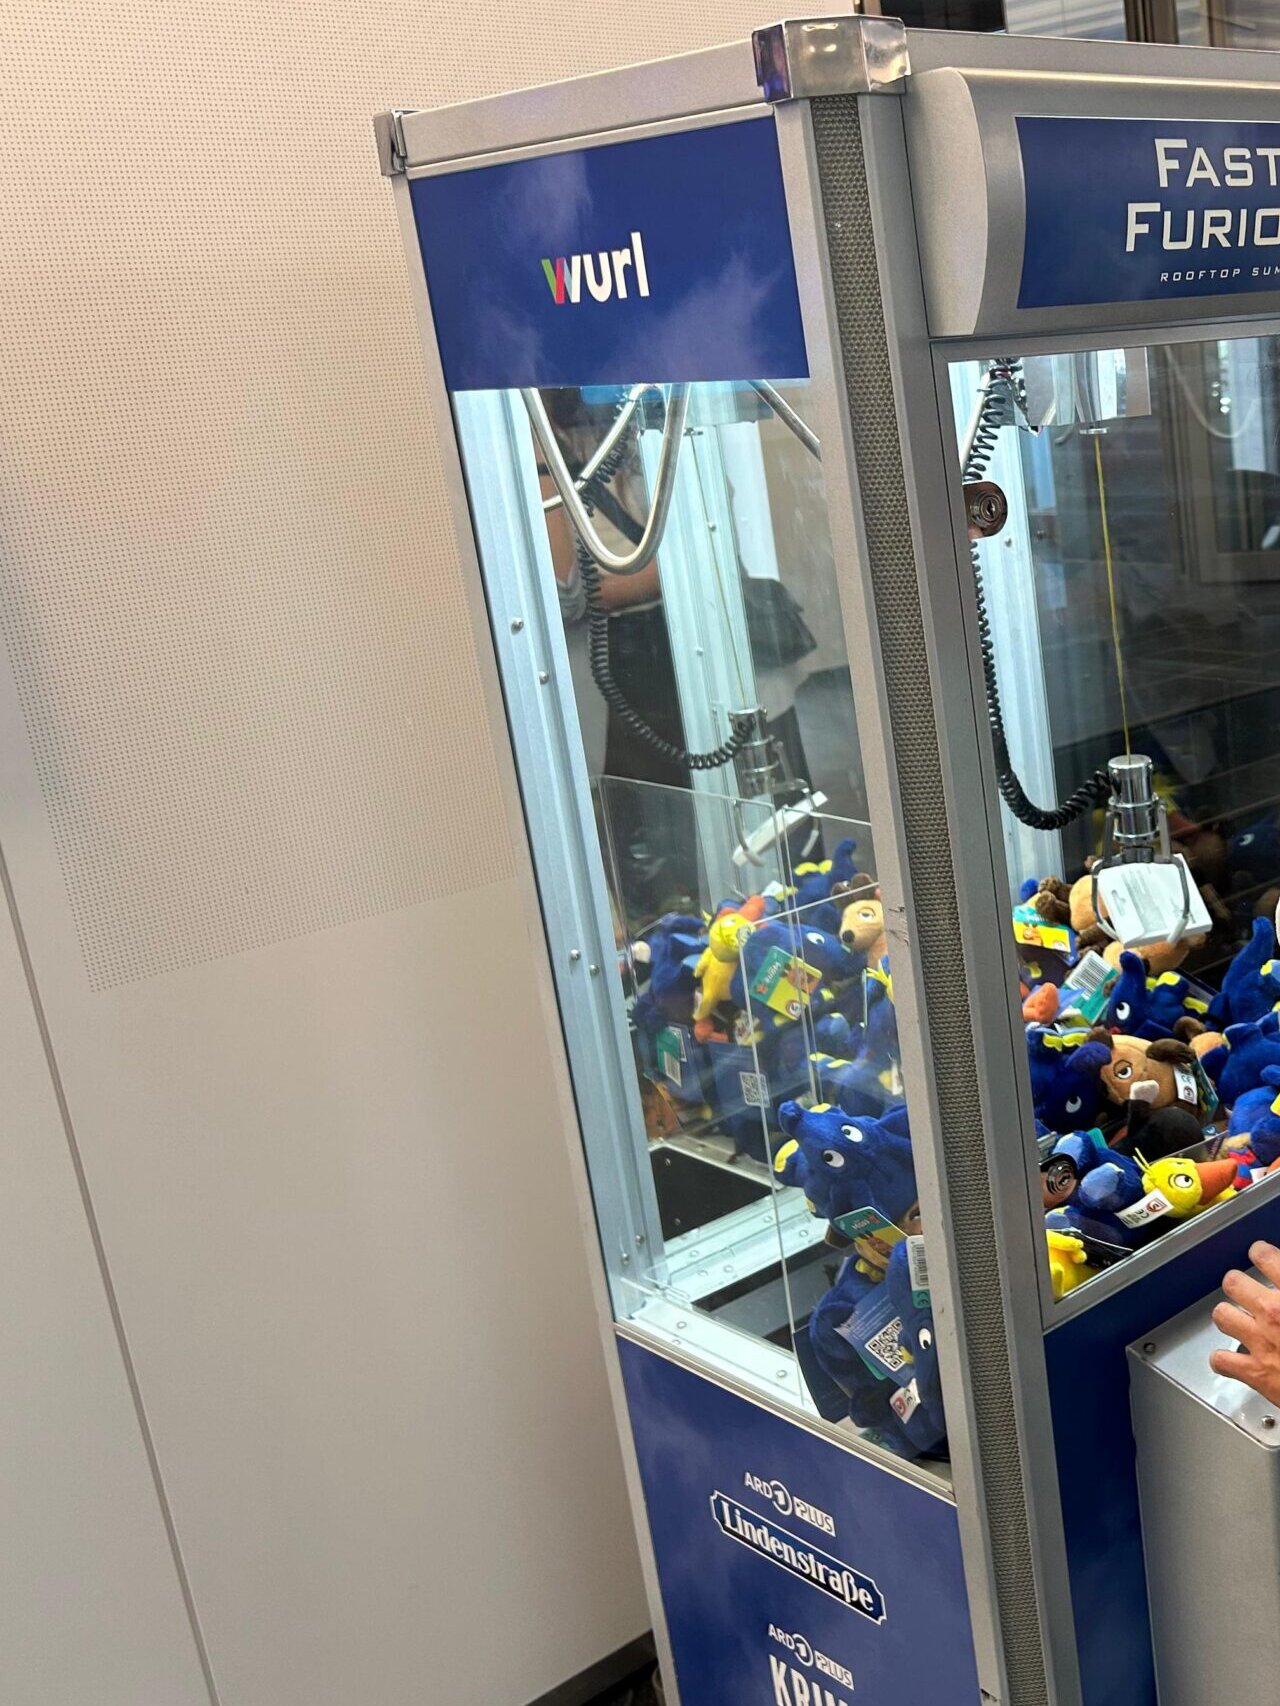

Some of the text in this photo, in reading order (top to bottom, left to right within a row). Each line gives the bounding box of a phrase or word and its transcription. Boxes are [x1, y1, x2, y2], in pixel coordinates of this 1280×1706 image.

[541, 231, 650, 304] wurl
[1160, 268, 1241, 282] ROOFTOP
[744, 1471, 773, 1499] ARD
[794, 1500, 834, 1534] PLUS
[721, 1500, 874, 1611] Lindenstraße
[768, 1623, 796, 1651] ARD
[815, 1652, 853, 1687] PLUS
